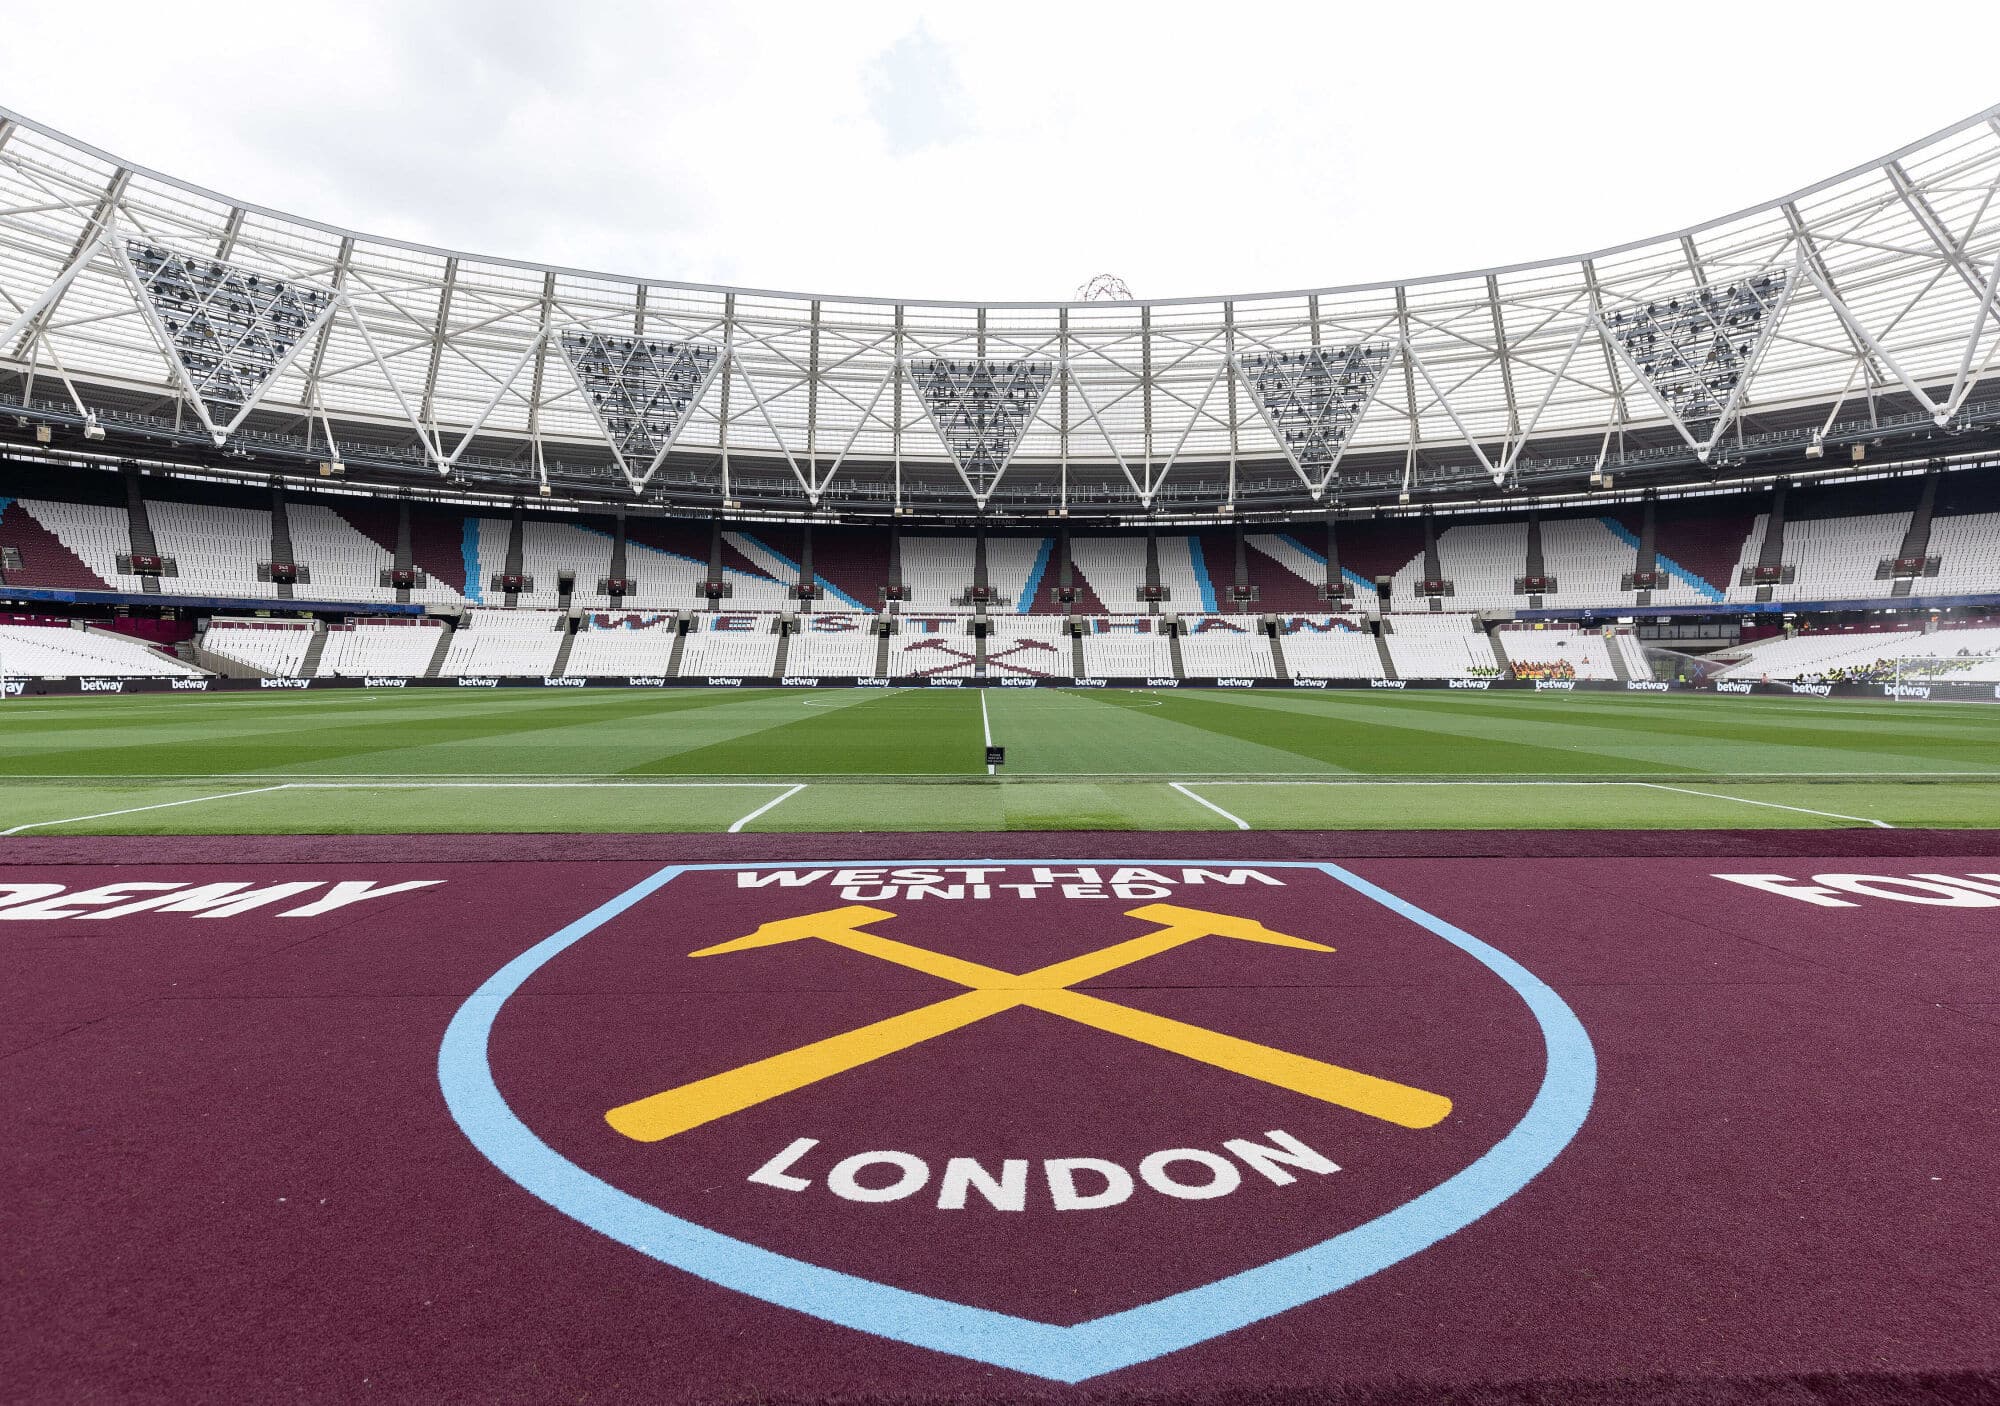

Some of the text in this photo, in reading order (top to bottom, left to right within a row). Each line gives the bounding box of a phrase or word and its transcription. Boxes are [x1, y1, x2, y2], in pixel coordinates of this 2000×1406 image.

[588, 614, 1363, 634] WEST HAM
[80, 679, 124, 692] betway
[172, 679, 208, 690] betway
[261, 677, 309, 689] betway
[365, 678, 406, 688] betway
[458, 678, 498, 688] betway
[545, 677, 586, 687] betway
[630, 678, 665, 687] betway
[709, 678, 742, 687] betway
[782, 678, 818, 687] betway
[858, 678, 890, 687] betway
[931, 678, 963, 687] betway
[1002, 677, 1037, 687] betway
[1076, 678, 1107, 687] betway
[1147, 678, 1179, 687] betway
[1218, 678, 1254, 688] betway
[1294, 679, 1328, 688] betway
[1371, 679, 1405, 689] betway
[1449, 679, 1491, 690] betway
[1536, 680, 1575, 690] betway
[1629, 681, 1669, 691] betway
[1717, 682, 1752, 694] betway
[1792, 683, 1832, 695] betway
[737, 867, 1287, 888] WEST HAM
[839, 884, 1172, 901] UNITED
[746, 1129, 1343, 1212] LONDON
